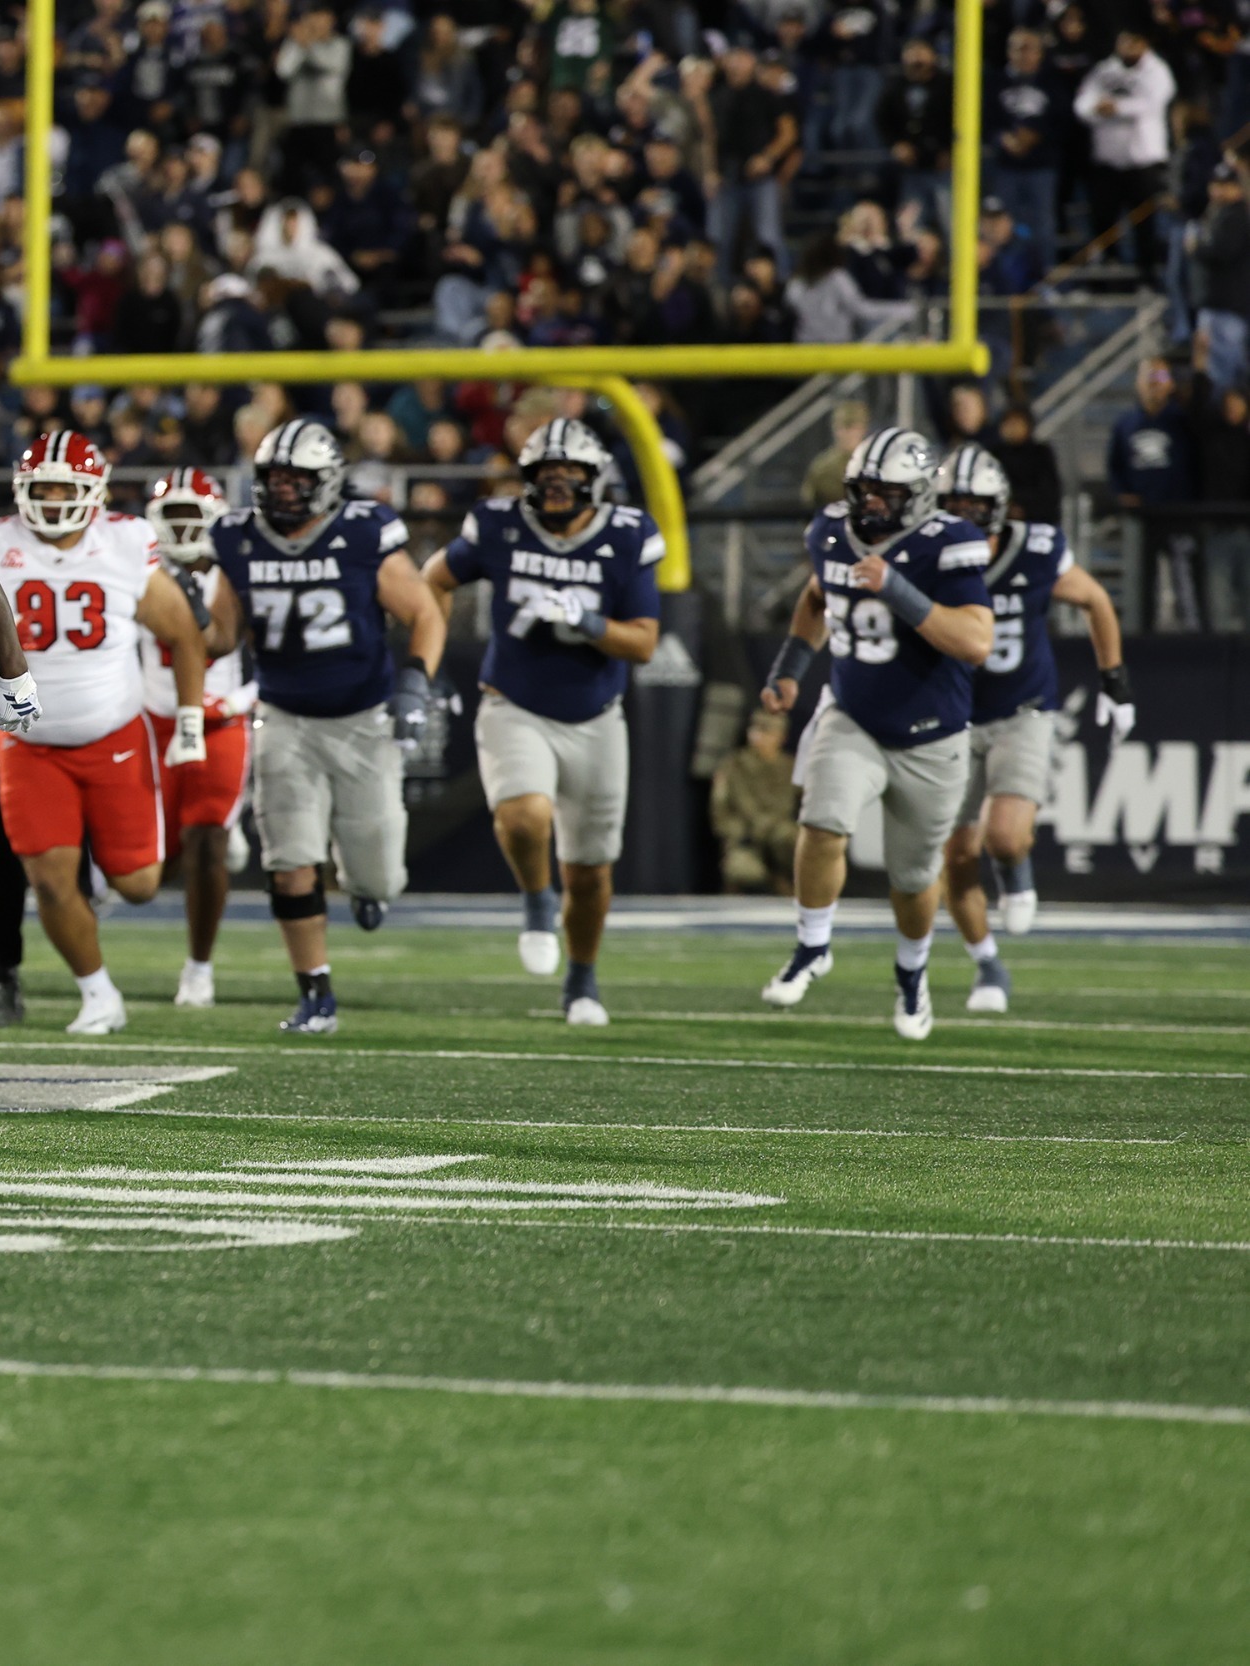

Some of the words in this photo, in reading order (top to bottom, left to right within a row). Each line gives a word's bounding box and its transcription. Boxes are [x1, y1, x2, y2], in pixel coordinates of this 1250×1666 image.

[248, 557, 342, 584] NEVADA
[510, 550, 604, 583] NEVADA
[251, 587, 352, 651] 72
[823, 591, 899, 665] 59
